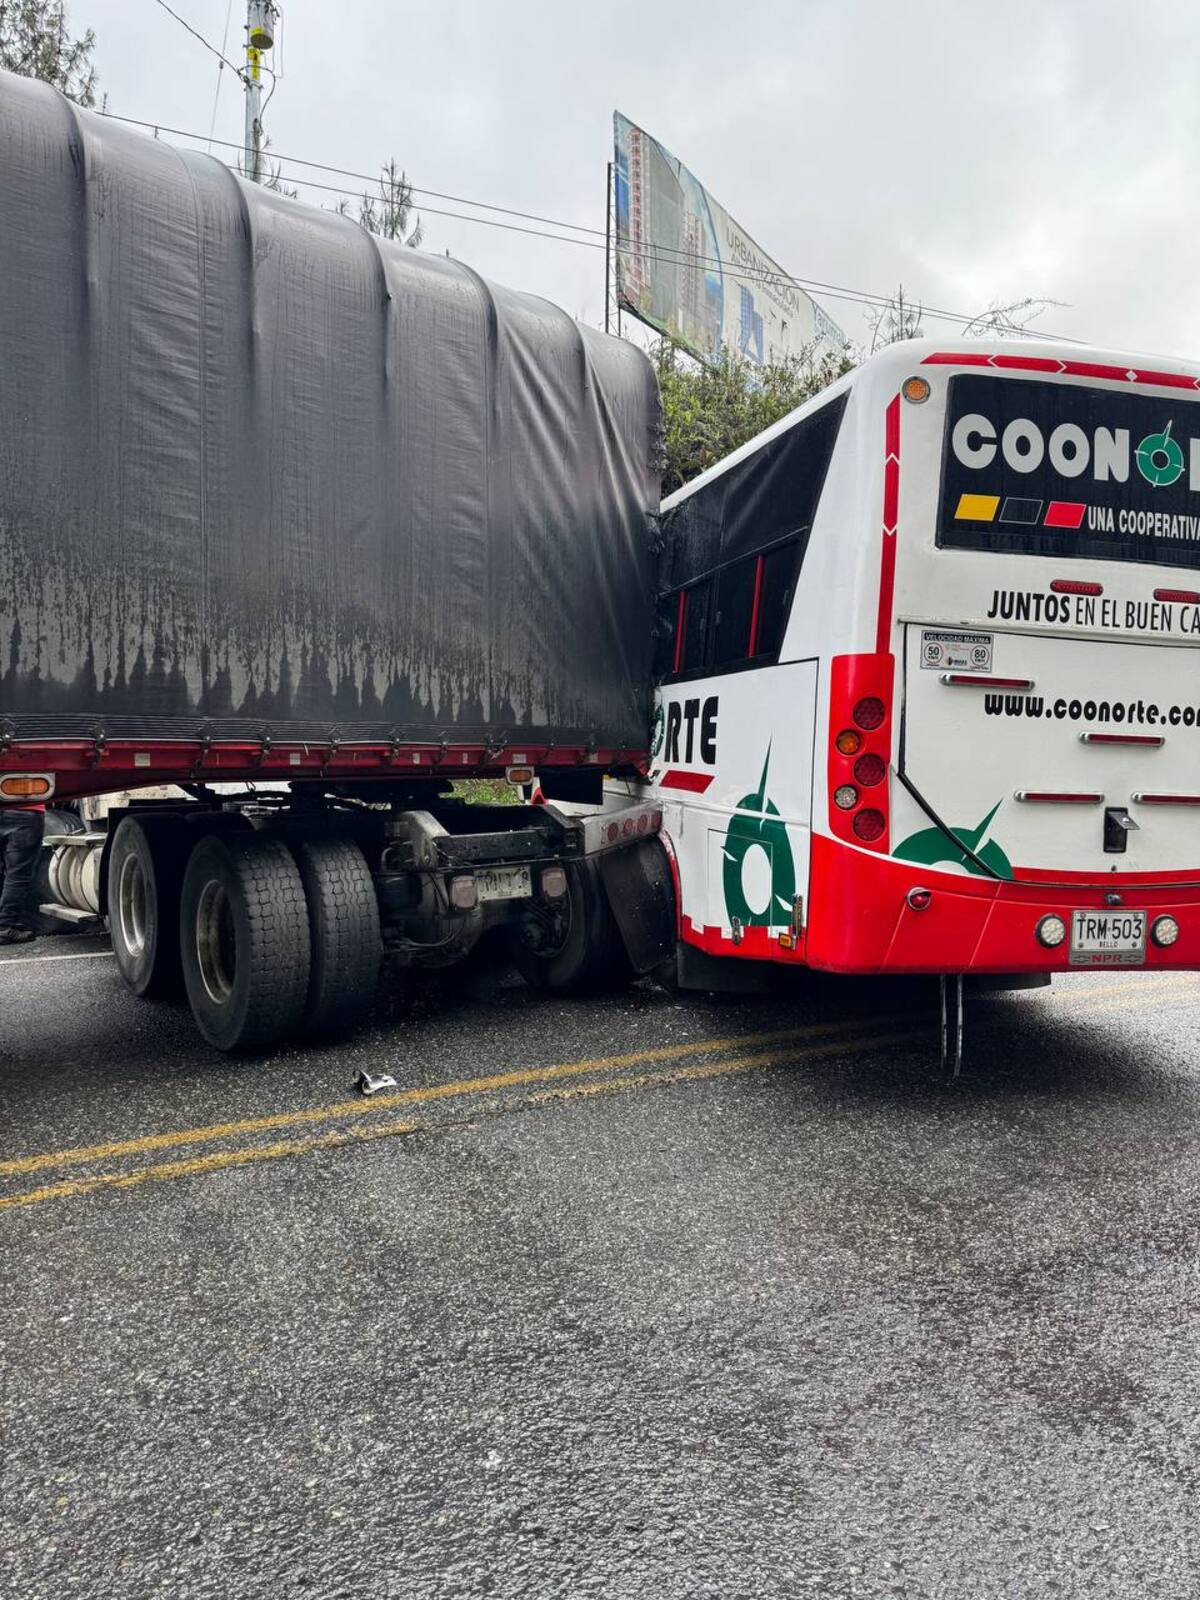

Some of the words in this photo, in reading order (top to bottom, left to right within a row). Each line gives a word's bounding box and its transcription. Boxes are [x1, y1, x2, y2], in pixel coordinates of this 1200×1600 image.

[1088, 506, 1115, 532] UNA
[987, 590, 1070, 623] JUNTOS
[1076, 597, 1095, 626] EN
[1101, 599, 1120, 628] EL
[1125, 601, 1172, 632] BUEN
[928, 646, 939, 655] 50
[974, 649, 986, 658] 80
[985, 694, 1200, 727] www.coonorte.co
[1092, 954, 1123, 963] NPR
